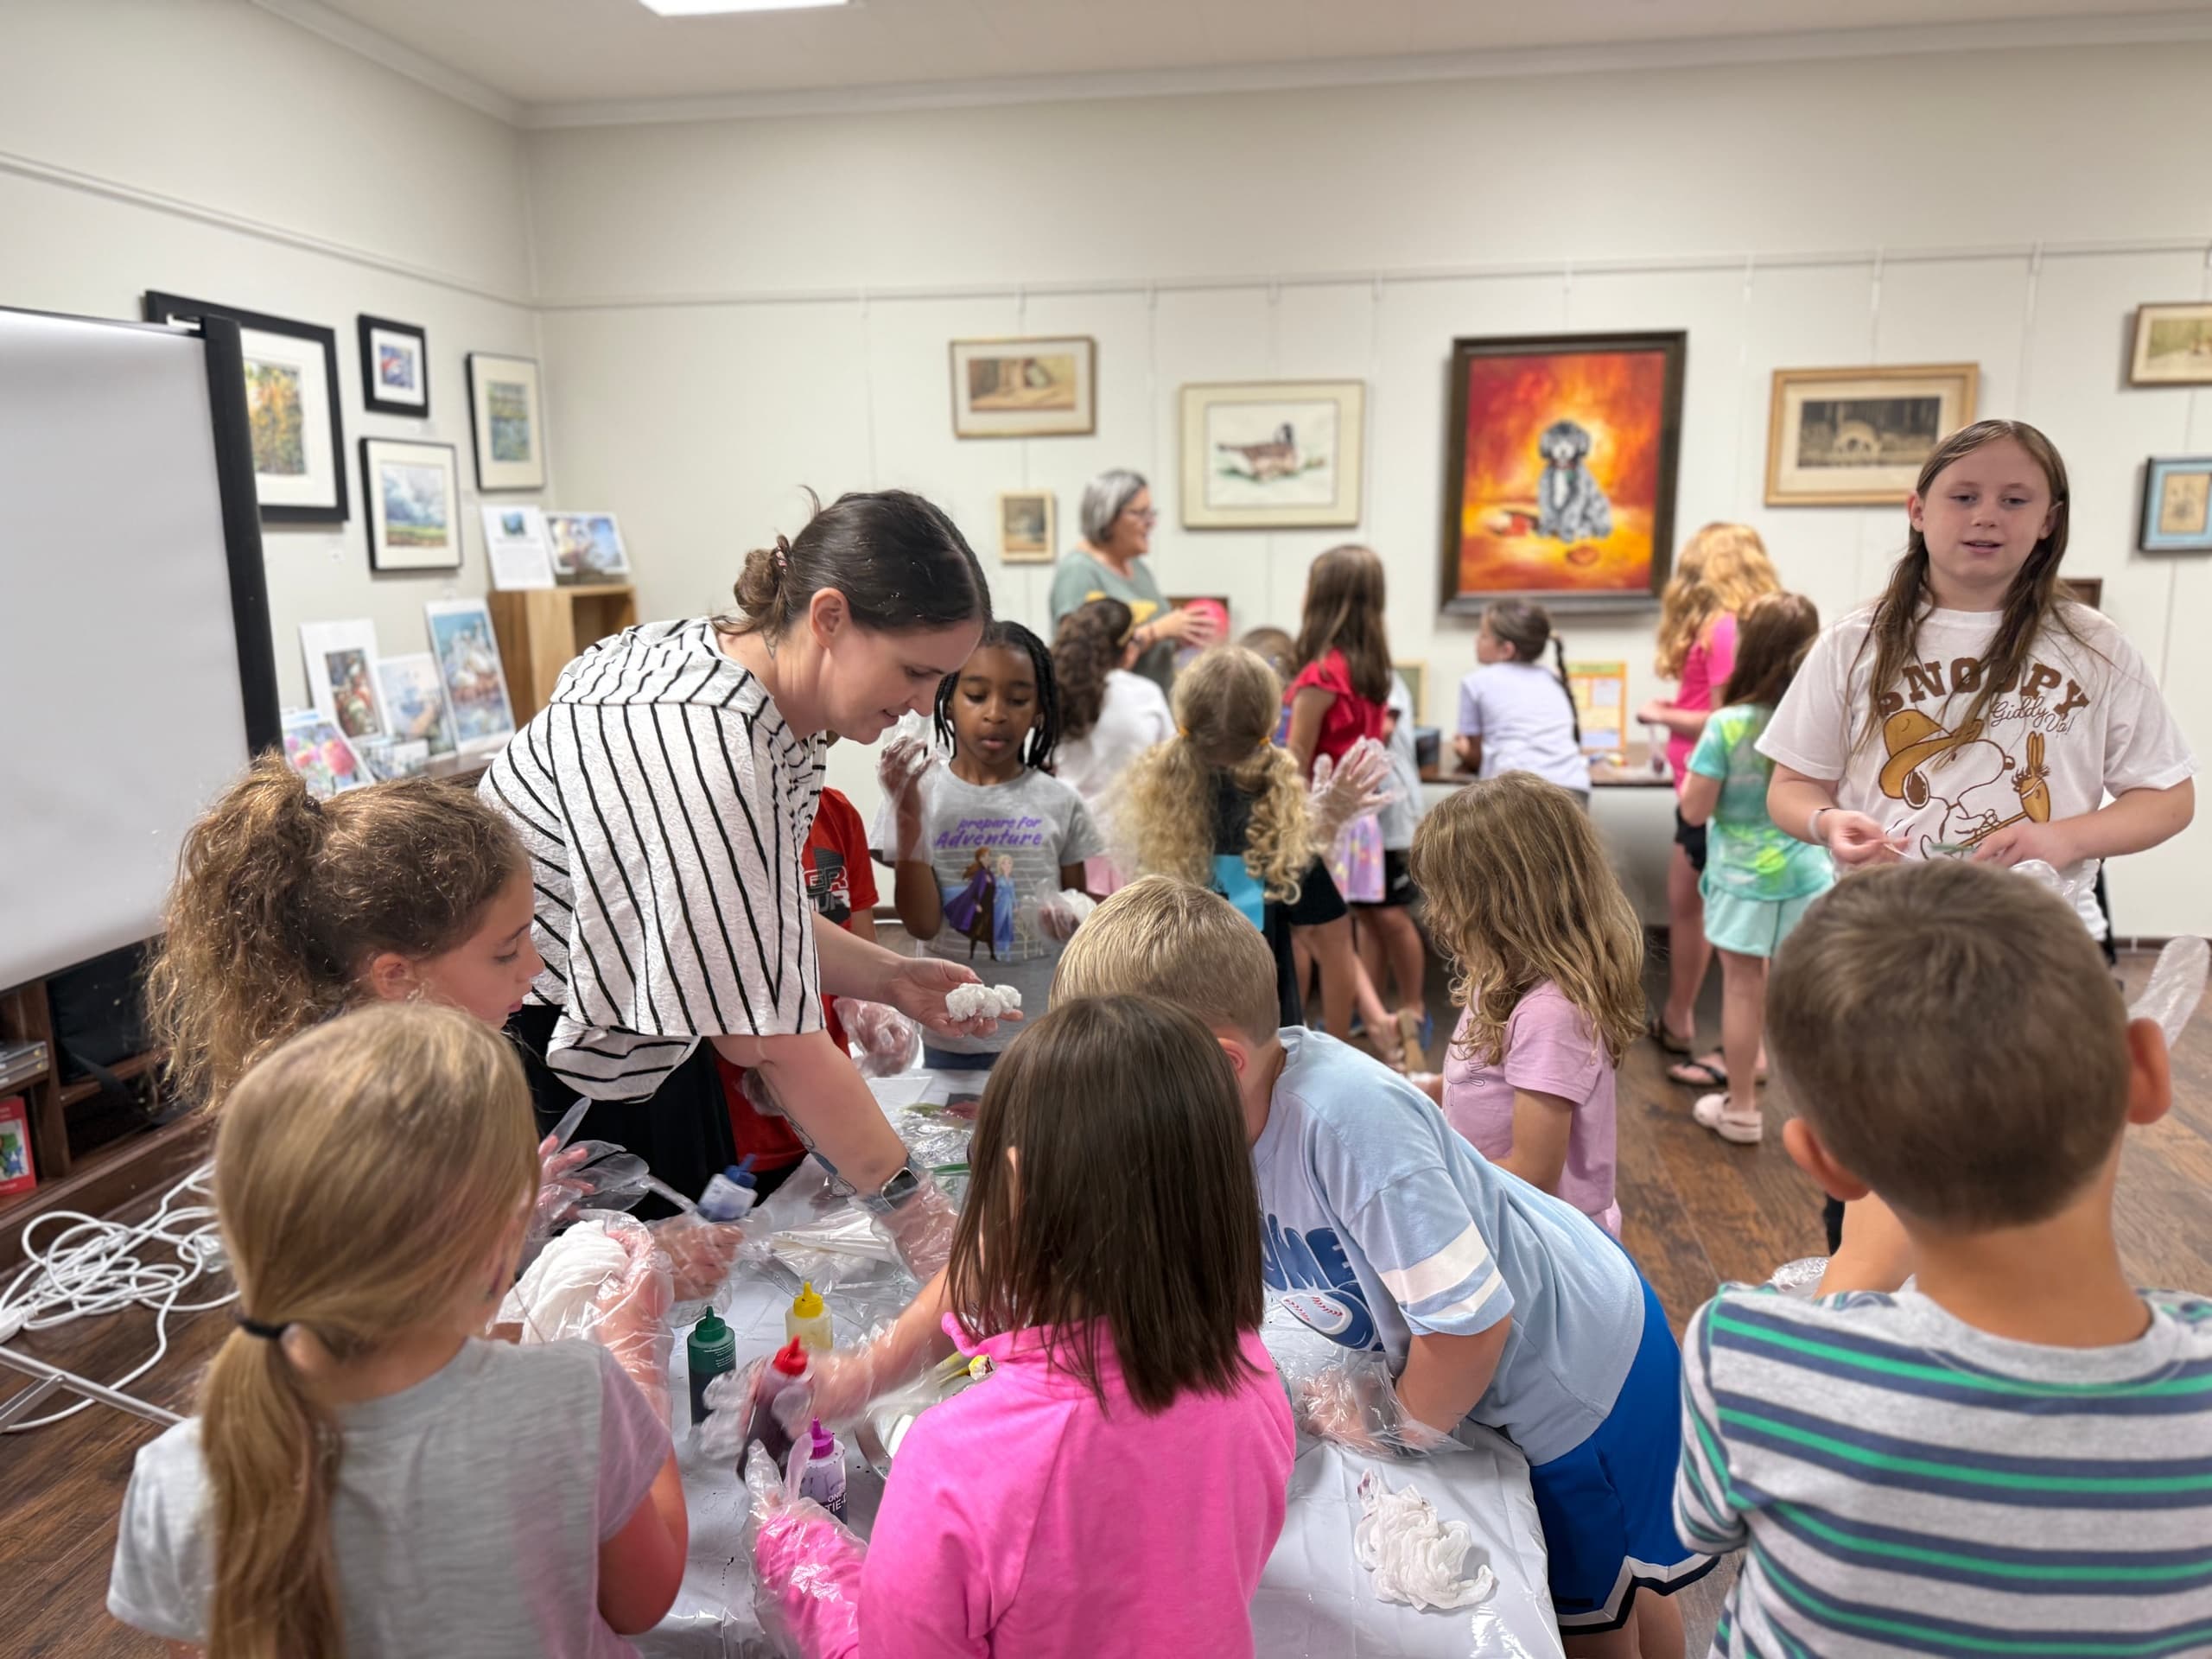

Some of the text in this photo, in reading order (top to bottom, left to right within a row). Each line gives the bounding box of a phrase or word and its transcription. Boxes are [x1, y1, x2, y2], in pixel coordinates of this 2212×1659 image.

[1991, 696, 2050, 728] Giddy
[957, 817, 1016, 831] prepare
[935, 830, 1043, 849] Adventure
